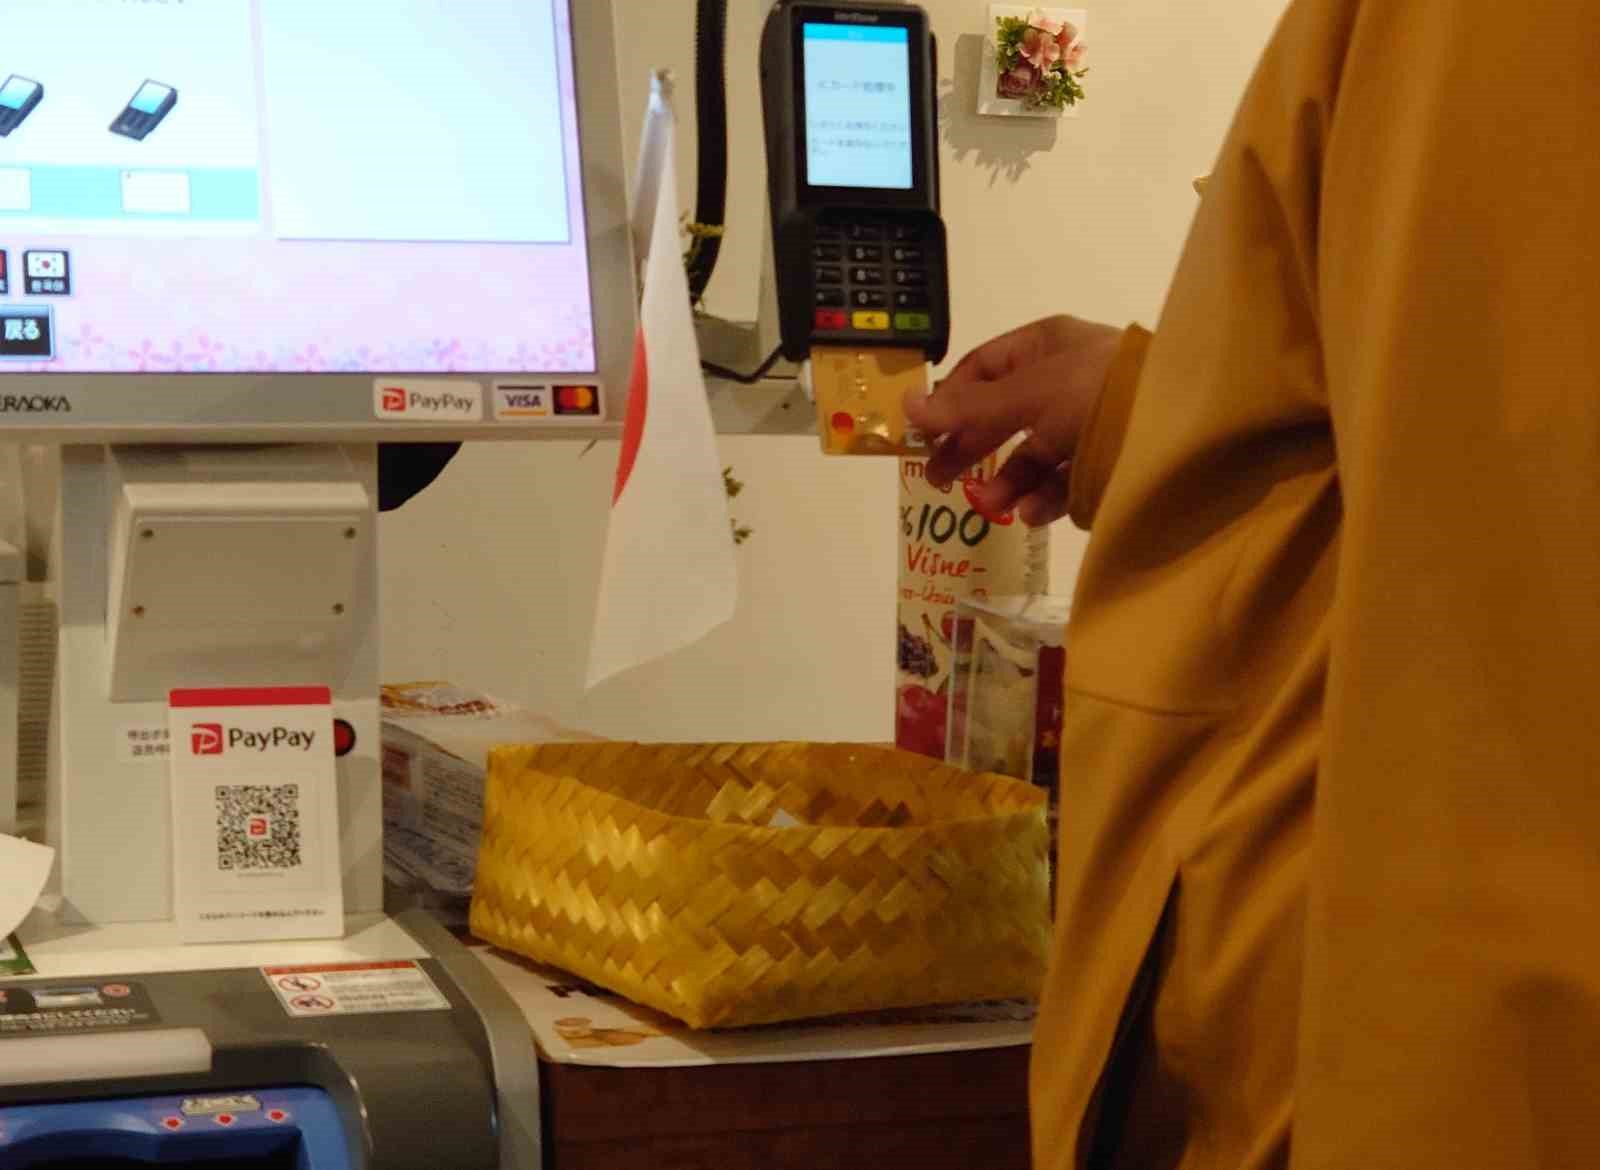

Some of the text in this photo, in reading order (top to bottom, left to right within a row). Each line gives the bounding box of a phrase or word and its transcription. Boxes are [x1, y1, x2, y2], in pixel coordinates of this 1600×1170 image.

[4, 318, 41, 341] 戻る
[409, 392, 473, 411] PayPay
[505, 393, 542, 408] VISA
[228, 726, 316, 752] PayPay
